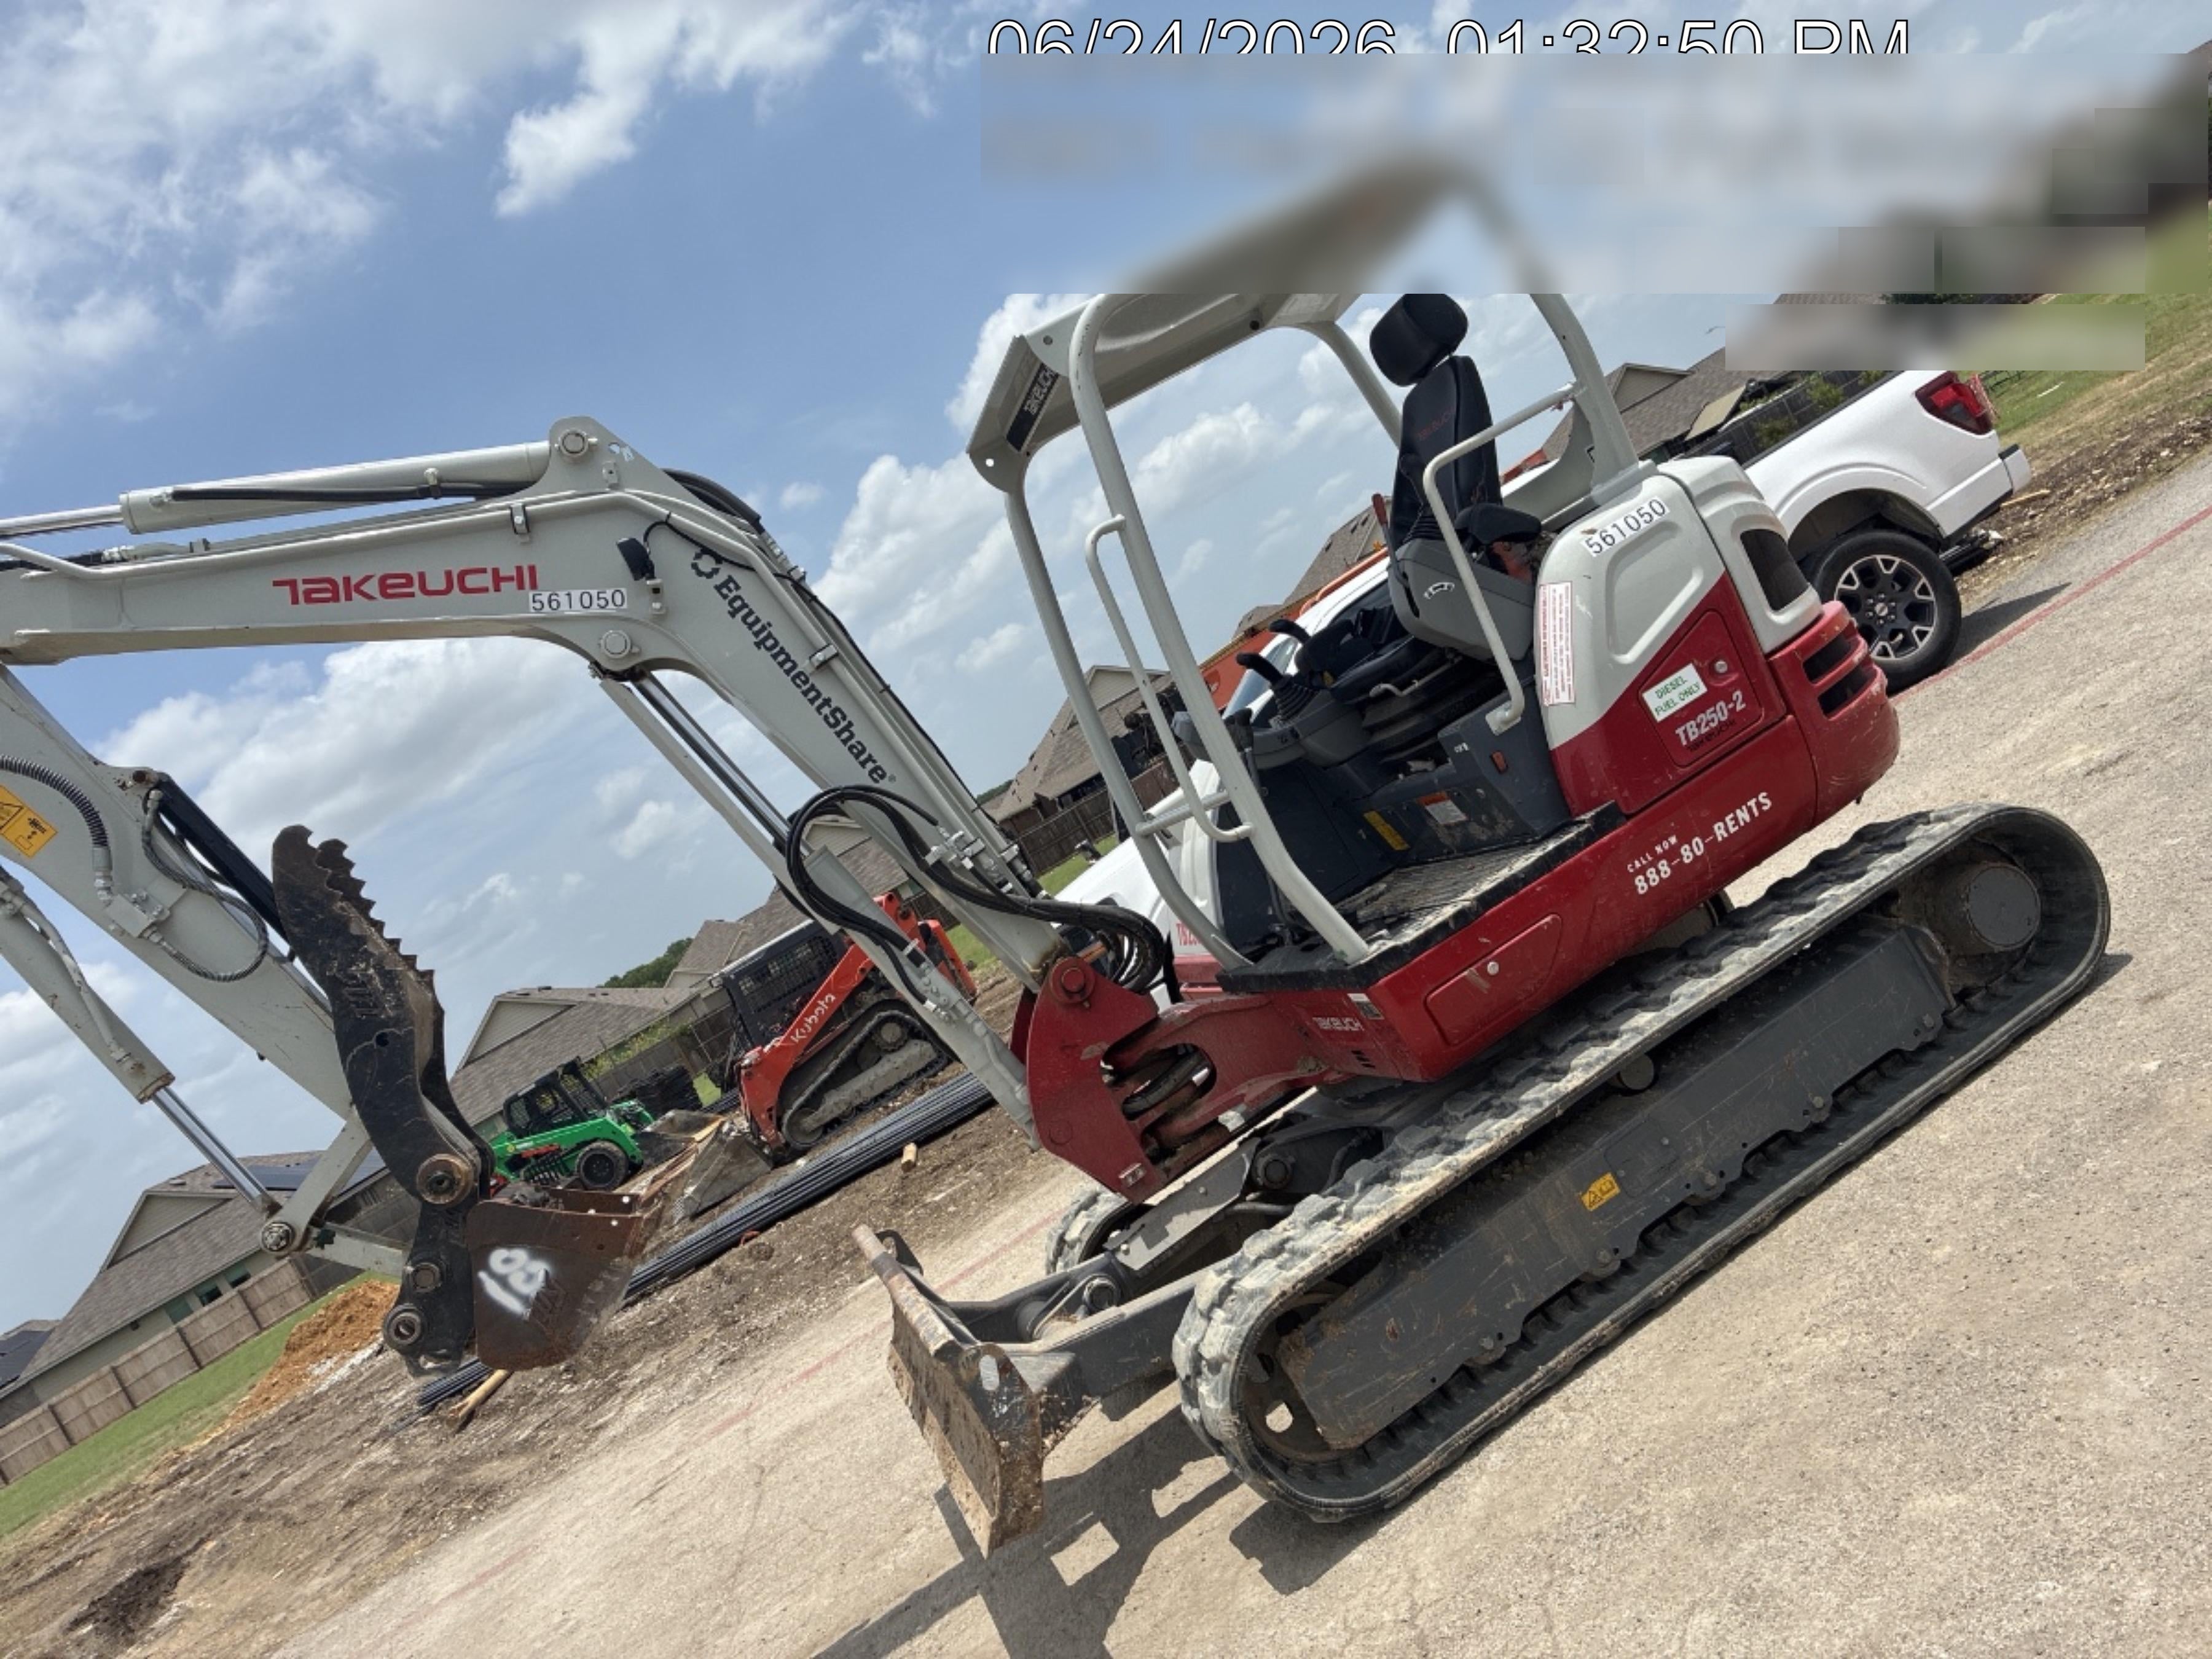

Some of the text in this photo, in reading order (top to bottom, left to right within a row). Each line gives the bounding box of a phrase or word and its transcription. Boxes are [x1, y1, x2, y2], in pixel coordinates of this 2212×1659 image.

[1585, 499, 1666, 554] 561050
[272, 565, 539, 605] TAKEUCHI
[531, 589, 626, 611] 561050
[1655, 676, 1687, 699] DIESEL
[1655, 682, 1701, 716] FUEL ONLY
[1675, 690, 1746, 746] TB250-2
[1627, 834, 1678, 873] CALL NOW
[791, 994, 836, 1043] Kubota
